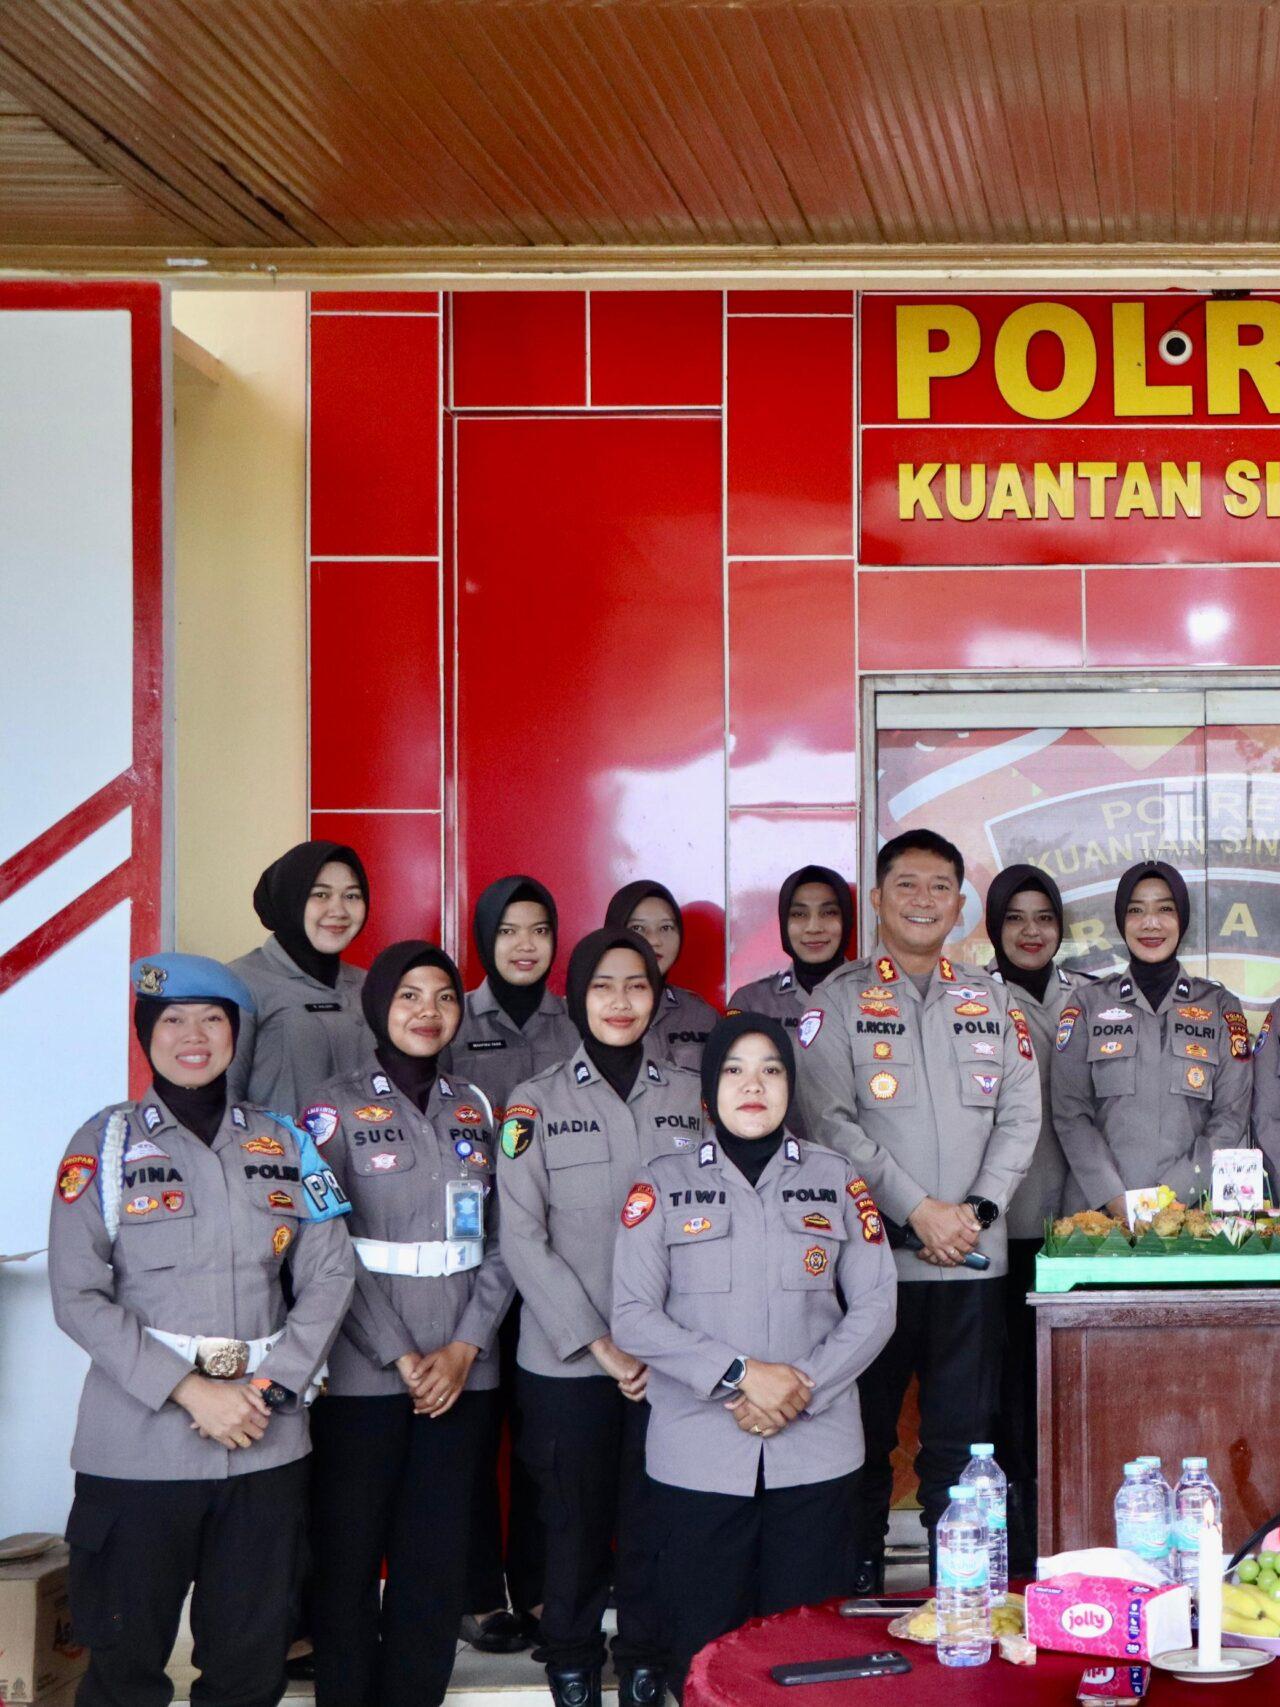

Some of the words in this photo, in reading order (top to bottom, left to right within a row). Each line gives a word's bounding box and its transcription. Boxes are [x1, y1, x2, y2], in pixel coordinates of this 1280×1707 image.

[899, 461, 1202, 521] KUANTAN
[1026, 828, 1206, 878] KUANTAN
[953, 1021, 1000, 1035] POLRI
[1092, 1024, 1134, 1037] DORA
[1174, 1023, 1215, 1039] POLRI
[547, 1120, 600, 1137] NADIA
[655, 1115, 700, 1131] POLRI
[354, 1128, 405, 1146] SUCI
[63, 1156, 95, 1167] PROPAM
[124, 1166, 183, 1188] VINA
[244, 1164, 299, 1182] POLRI
[669, 1189, 726, 1206] TIWI
[782, 1188, 838, 1203] POLRI
[1069, 1610, 1106, 1631] jolly
